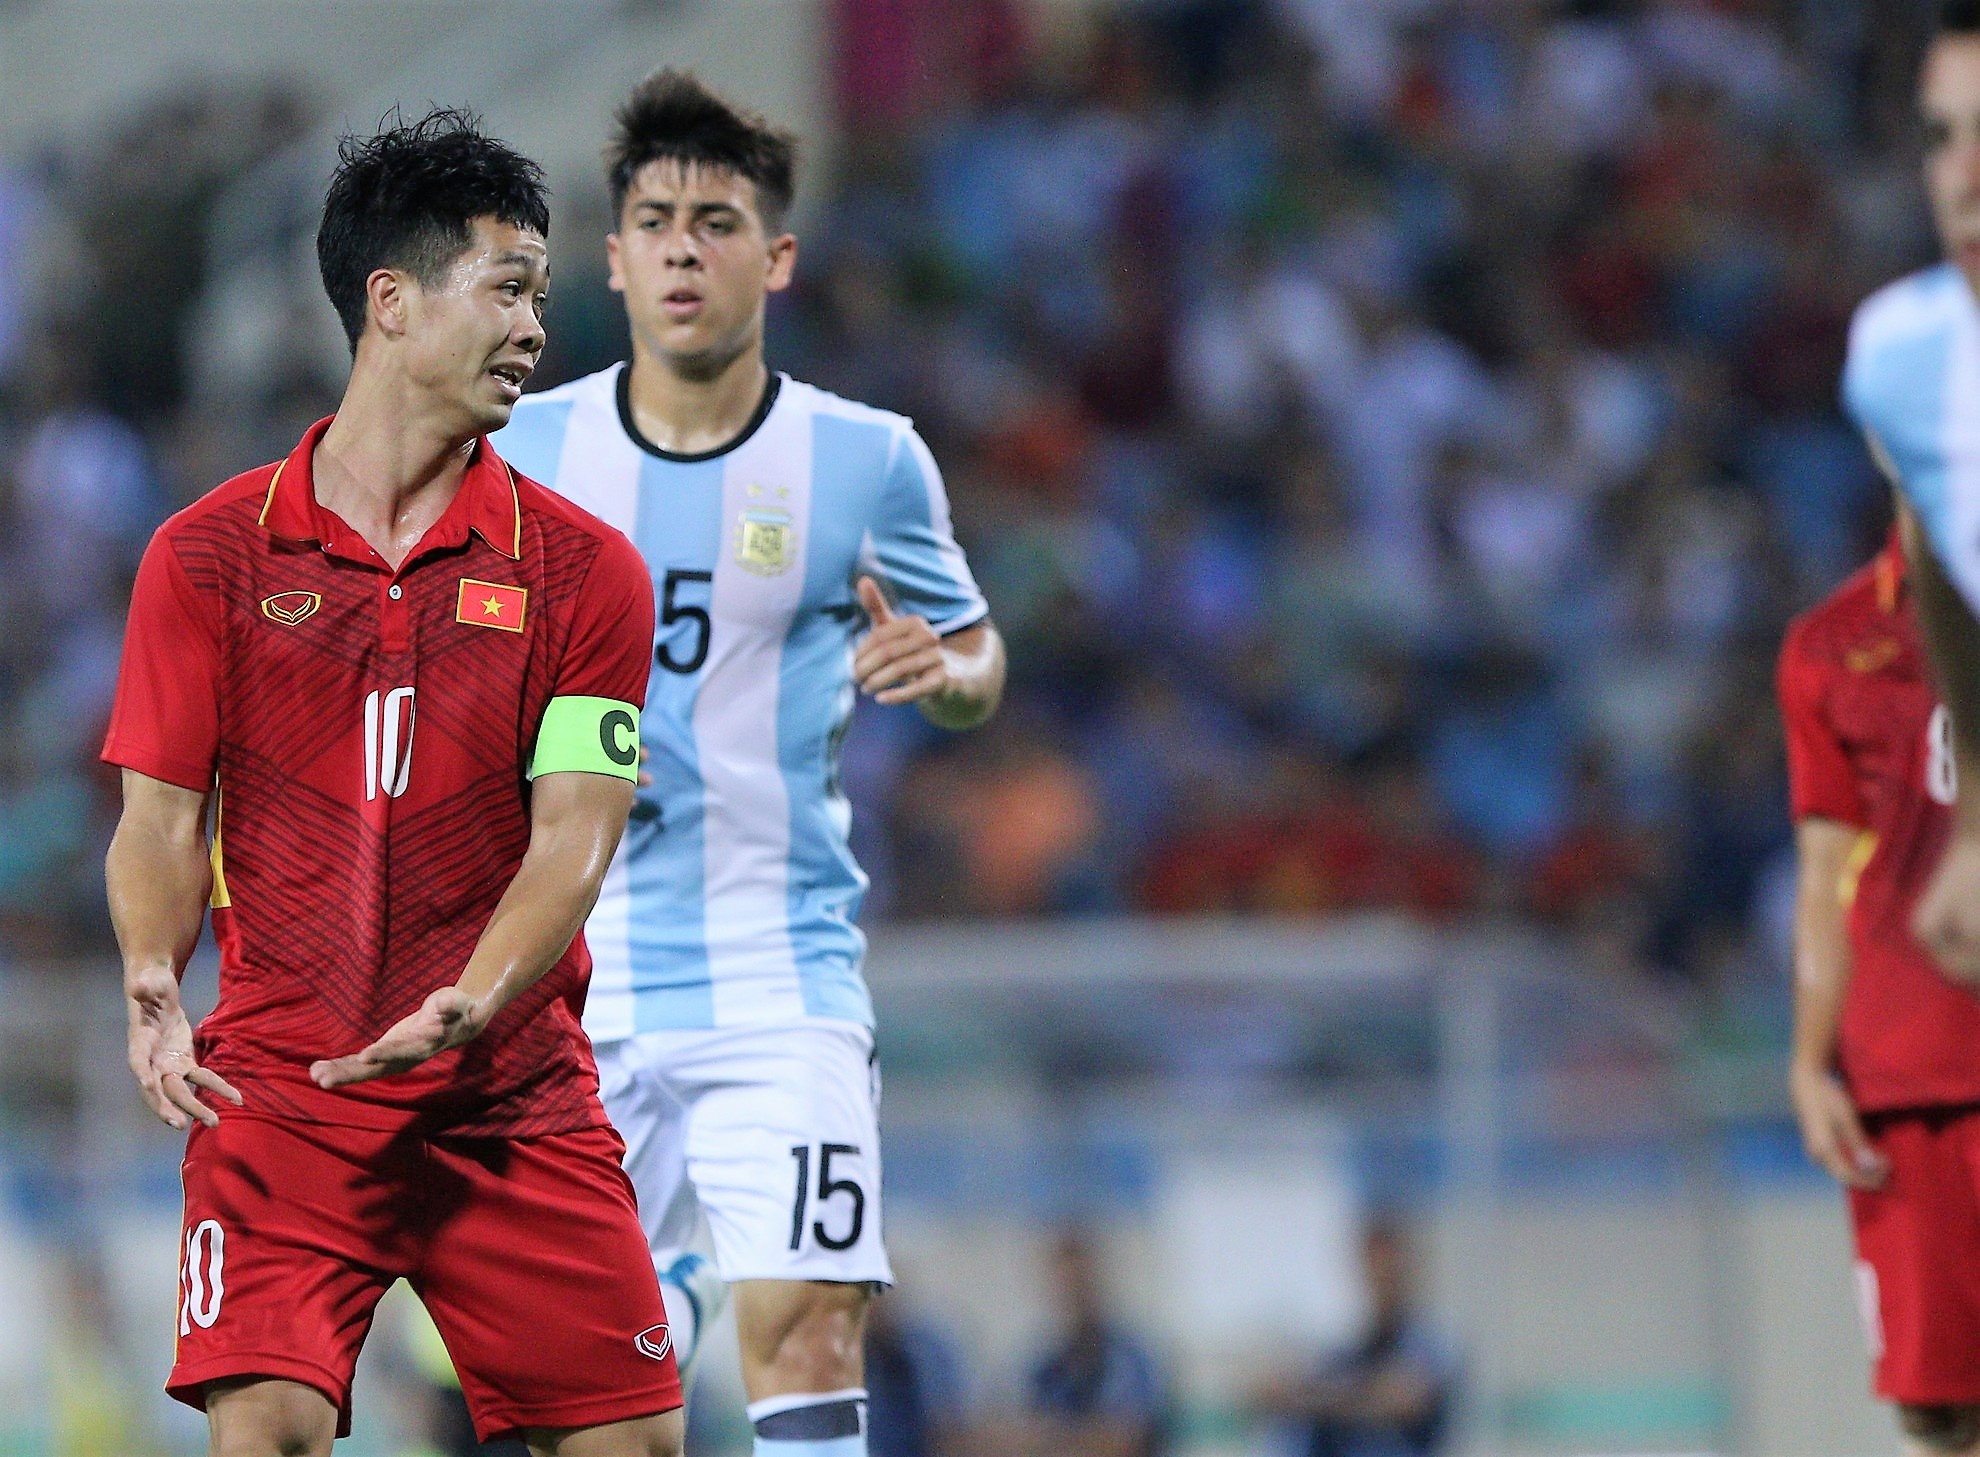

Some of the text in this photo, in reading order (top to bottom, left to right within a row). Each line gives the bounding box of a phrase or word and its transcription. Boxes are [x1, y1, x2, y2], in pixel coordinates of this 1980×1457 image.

[364, 687, 416, 801] 10
[600, 710, 637, 766] C
[789, 1143, 865, 1250] 15
[180, 1219, 224, 1337] 10
